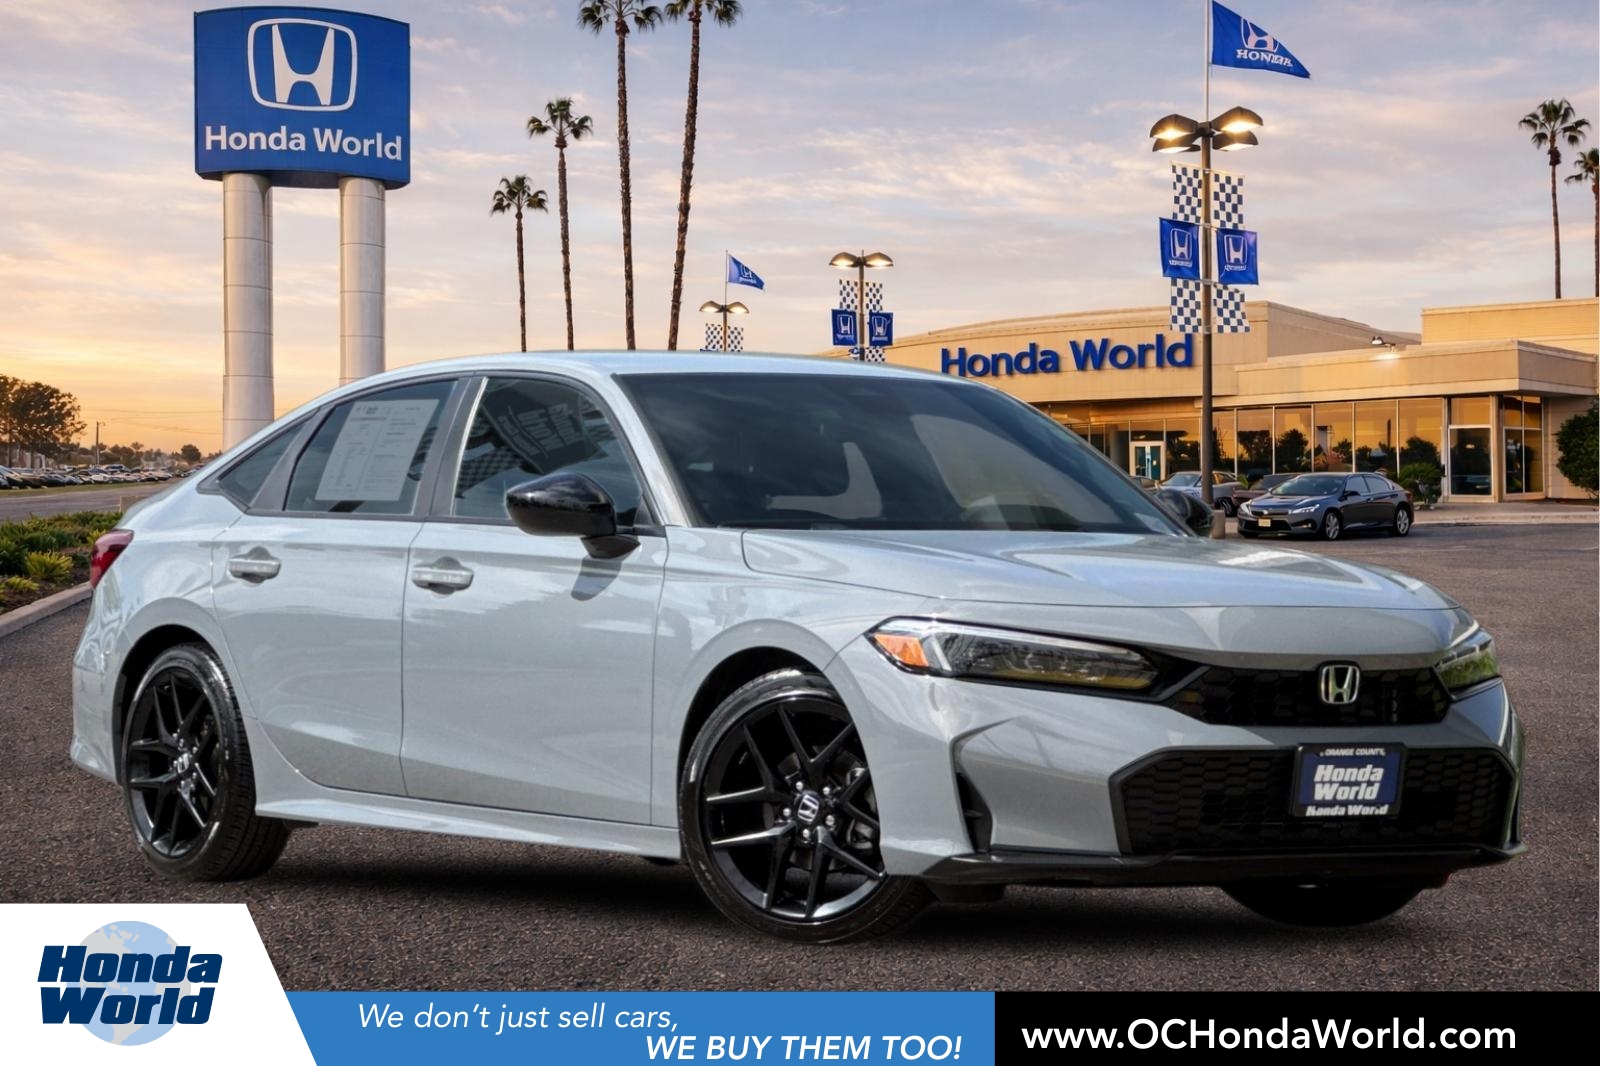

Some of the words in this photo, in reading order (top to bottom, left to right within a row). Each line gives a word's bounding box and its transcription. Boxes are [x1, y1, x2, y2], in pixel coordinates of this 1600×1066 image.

[205, 125, 306, 151] Honda
[313, 127, 402, 161] World
[941, 342, 1061, 377] Honda
[1069, 333, 1194, 371] World
[1314, 764, 1384, 782] Honda
[1314, 783, 1380, 801] World
